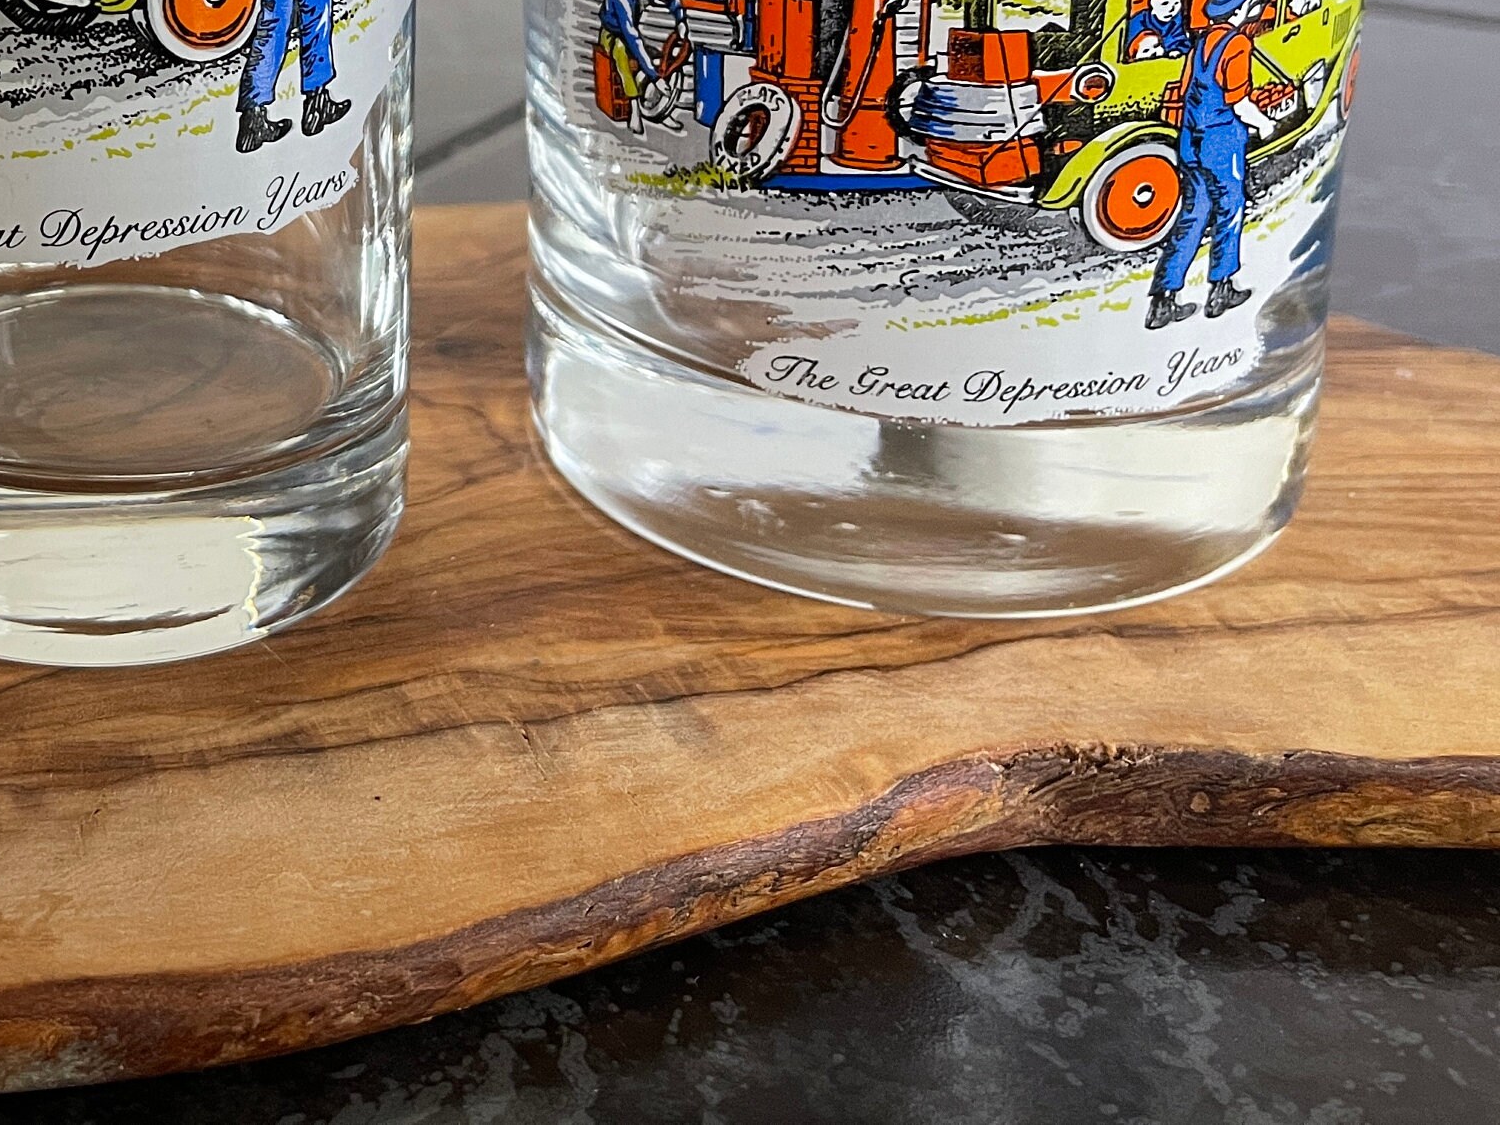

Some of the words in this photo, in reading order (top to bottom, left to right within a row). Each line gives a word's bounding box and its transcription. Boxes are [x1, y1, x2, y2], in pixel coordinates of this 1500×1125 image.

[737, 86, 785, 112] FLATS
[714, 141, 761, 175] FIXED
[40, 205, 249, 261] Depression
[256, 169, 351, 231] Years
[765, 354, 840, 392] The
[848, 364, 951, 403] Great
[963, 369, 1150, 415] Depression
[1157, 343, 1245, 396] Years
